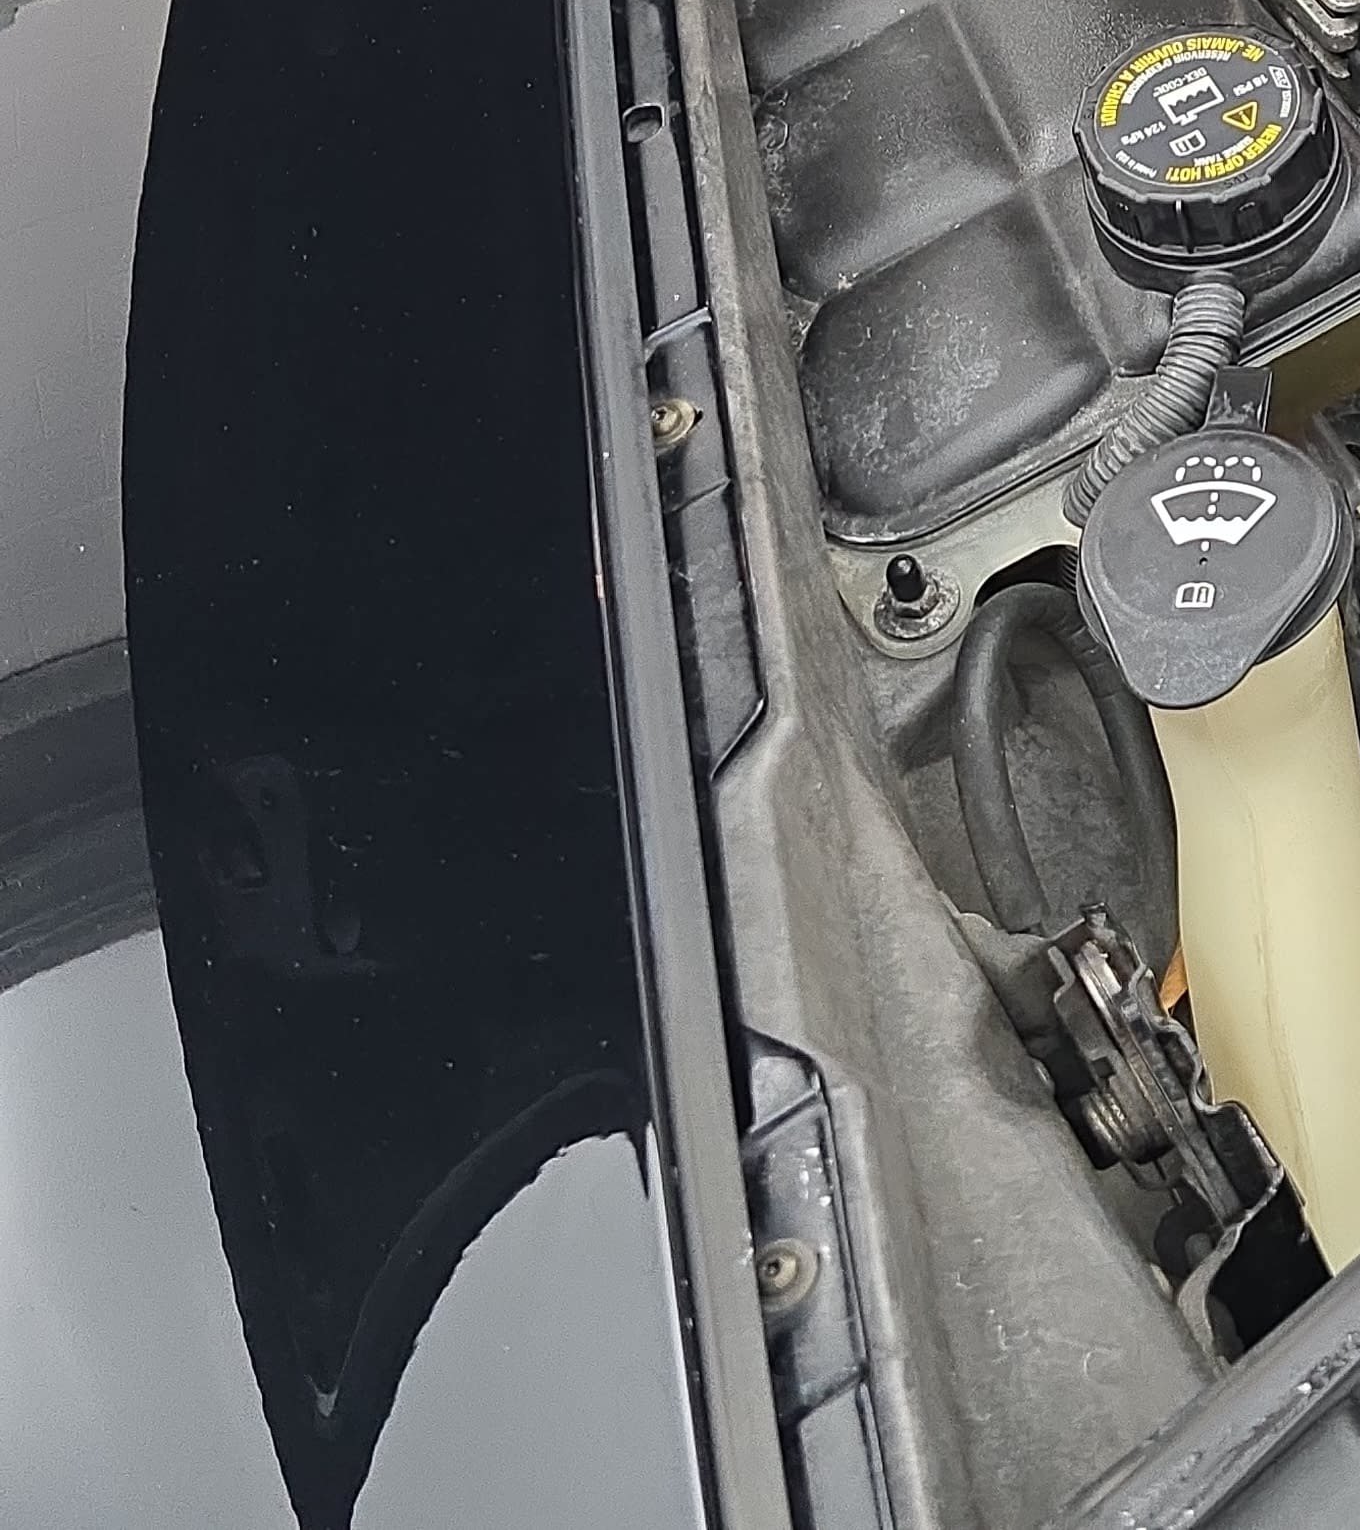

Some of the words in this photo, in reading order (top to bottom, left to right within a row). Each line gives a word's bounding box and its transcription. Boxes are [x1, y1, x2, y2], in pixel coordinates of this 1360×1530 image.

[1186, 36, 1245, 53] JAMAIS
[1242, 44, 1265, 62] NE
[1130, 41, 1184, 72] OUVRIR
[1233, 81, 1254, 97] PSI
[1101, 81, 1128, 127] CHAUD!
[1144, 120, 1167, 139] 124
[1242, 124, 1282, 157] NEVER
[1194, 153, 1225, 166] TANK
[1205, 154, 1244, 179] OPEN
[1165, 167, 1201, 182] HOT!
